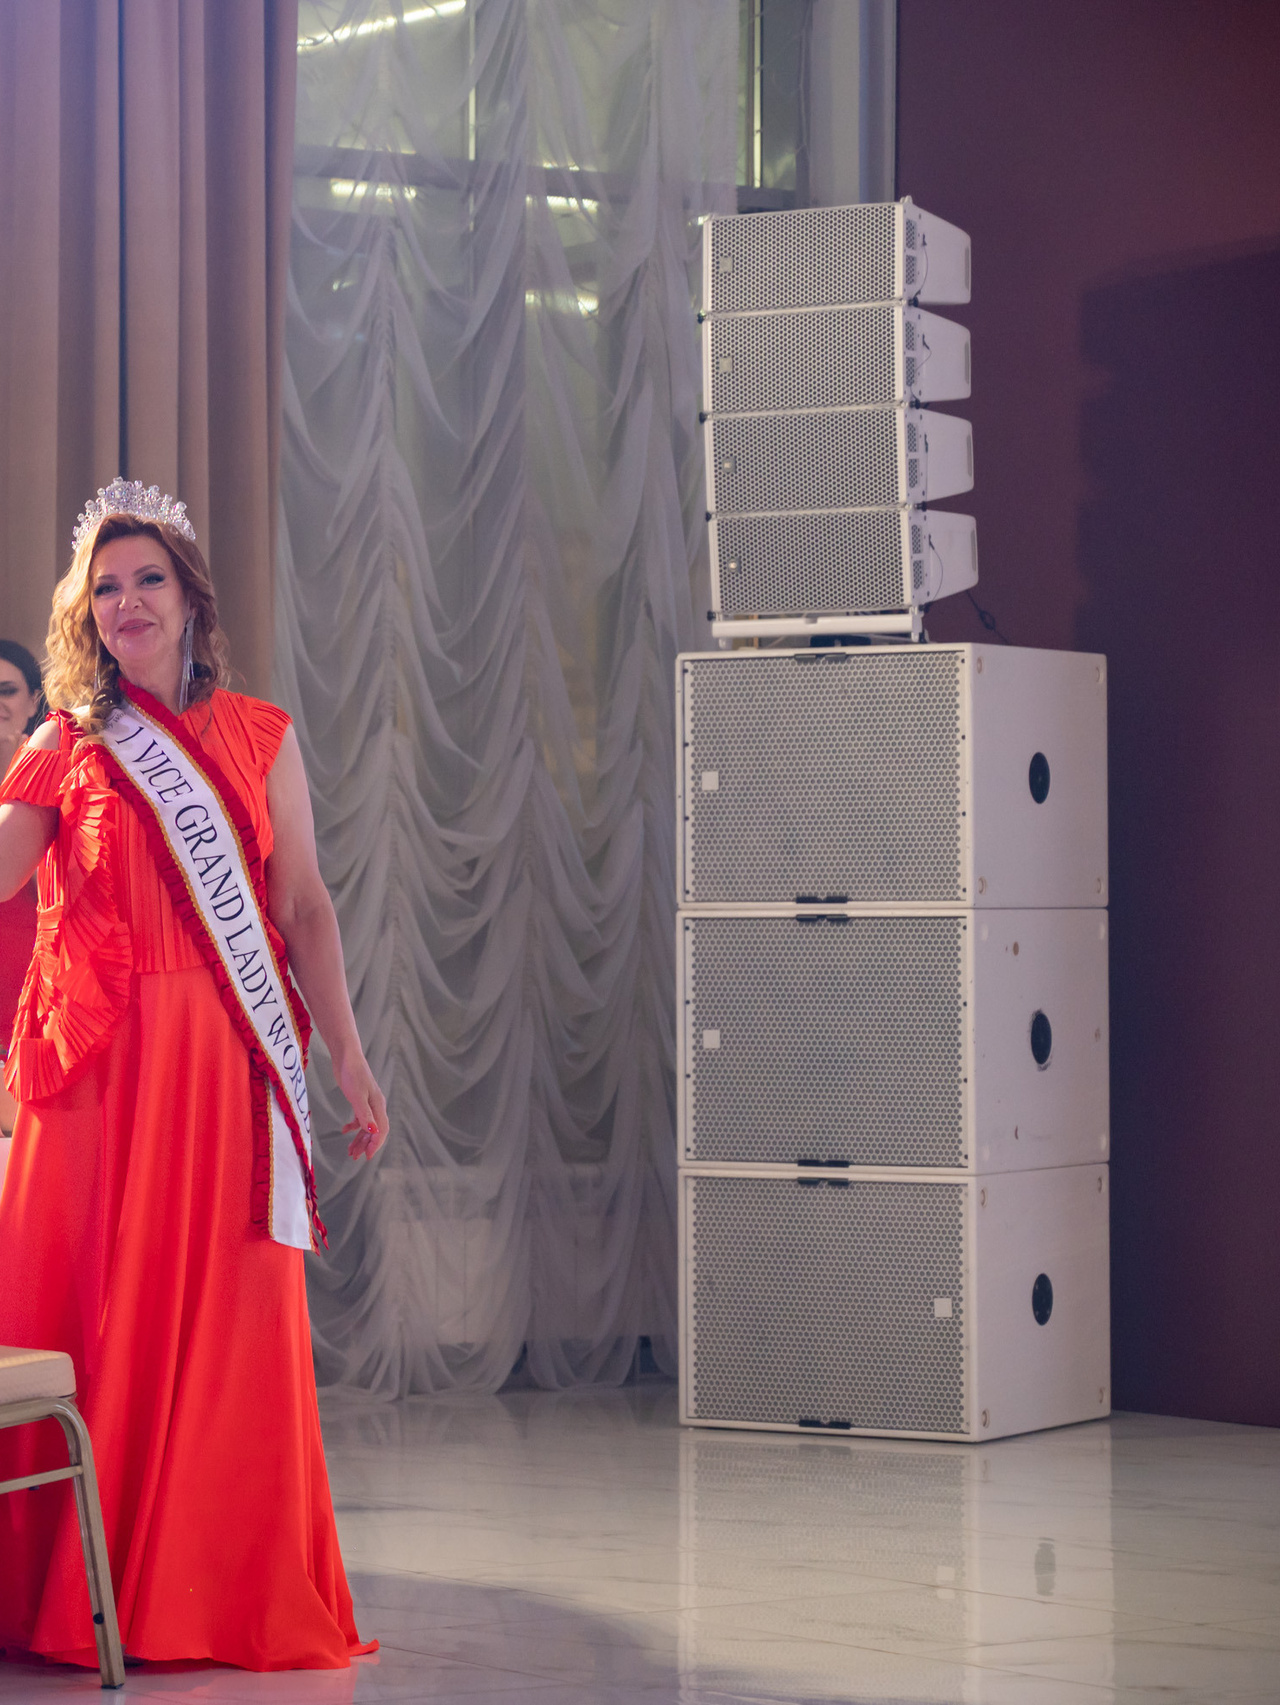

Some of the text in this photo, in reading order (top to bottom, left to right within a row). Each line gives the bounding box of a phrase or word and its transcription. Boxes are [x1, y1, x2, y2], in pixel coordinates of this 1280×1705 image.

[132, 739, 193, 803] VICE
[175, 804, 245, 922] GRAND
[225, 920, 277, 1013] LADY
